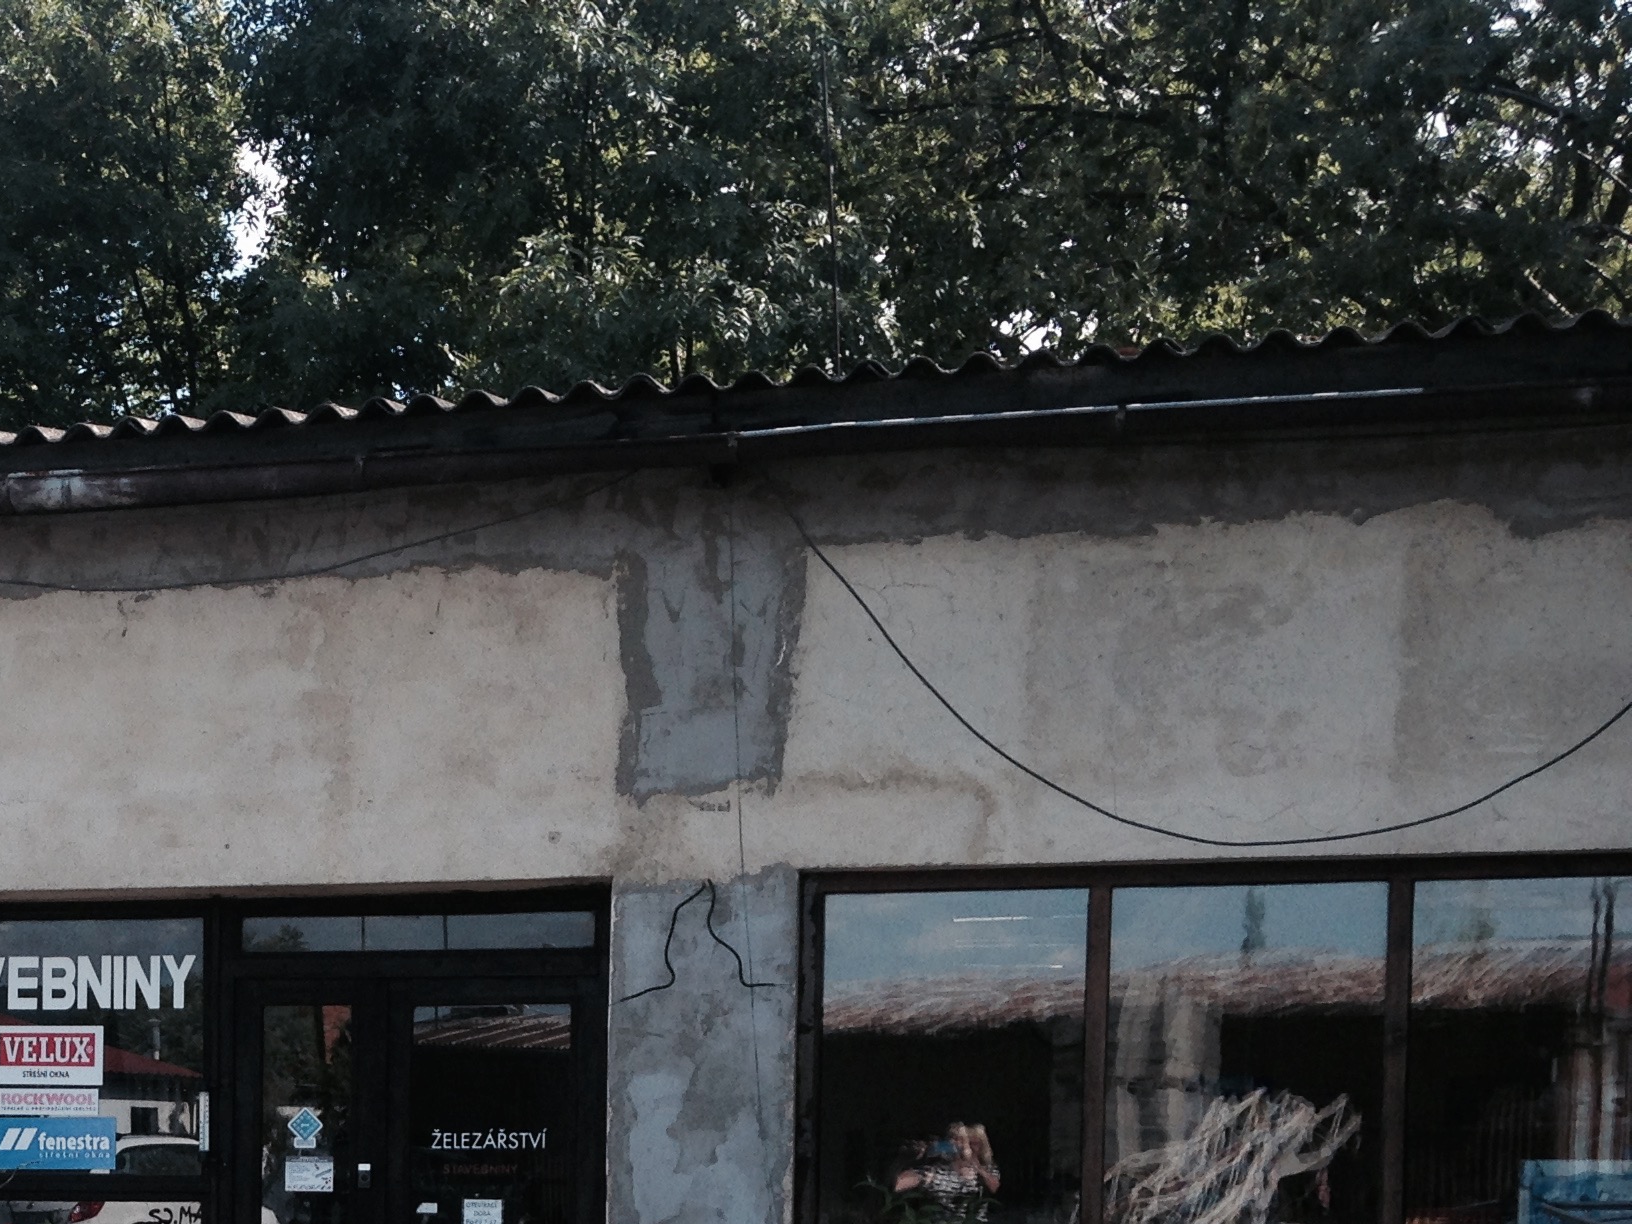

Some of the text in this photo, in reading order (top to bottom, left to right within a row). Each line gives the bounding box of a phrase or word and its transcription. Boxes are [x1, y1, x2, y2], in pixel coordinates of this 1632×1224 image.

[2, 1035, 92, 1064] VELUX
[0, 1092, 95, 1106] ROCKWOOL
[37, 1131, 111, 1151] fenestra
[430, 1127, 548, 1150] ŽELEZÁŘSTVÍ
[84, 1150, 111, 1159] okna
[443, 1163, 518, 1176] STAVEBNINY
